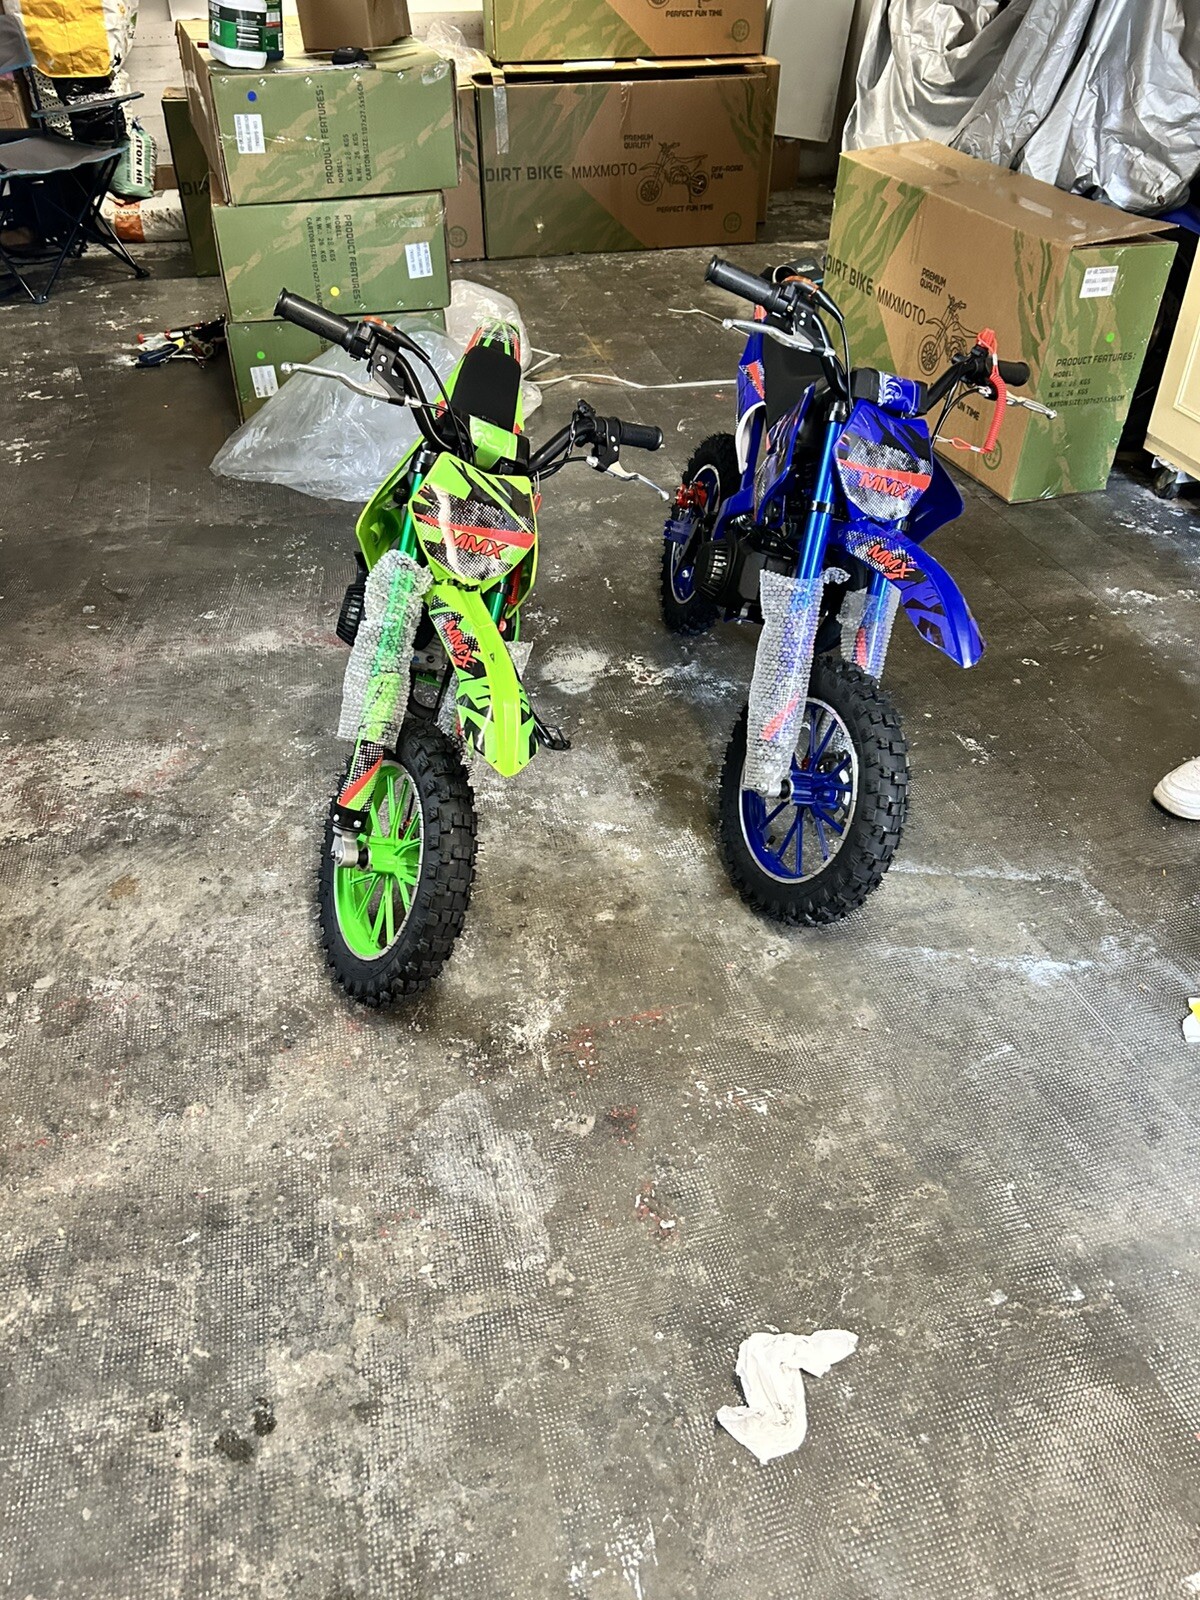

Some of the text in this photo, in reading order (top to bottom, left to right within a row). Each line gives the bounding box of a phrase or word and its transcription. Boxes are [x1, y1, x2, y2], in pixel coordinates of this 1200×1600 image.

[665, 8, 722, 17] PERFECT FUN TIME
[316, 85, 334, 184] PRODUCT FEATURES:
[342, 133, 350, 147] KGS
[351, 132, 359, 147] KGS
[623, 133, 654, 141] PREMIUM
[623, 141, 651, 149] QUALITY
[363, 153, 372, 181] CARTON
[485, 162, 637, 182] DIRT BIKE MMXMOTO
[711, 164, 744, 172] OFF-ROAD
[711, 172, 724, 180] FUN
[656, 203, 714, 213] PERFECT FUN TIME
[306, 217, 314, 243] CARTON
[344, 214, 361, 304] PRODUCT FEATURES:
[921, 267, 947, 288] PREMIUM
[825, 254, 926, 325] DIRT BIKE MMXMOTO
[920, 278, 943, 296] QUALITY
[1055, 352, 1136, 367] PRODUCT FEATURES:
[1077, 388, 1089, 396] KGS
[966, 404, 980, 421] TIME
[858, 472, 911, 500] MMX
[440, 529, 509, 560] MMX
[867, 544, 916, 579] MMX
[443, 619, 477, 668] MMX
